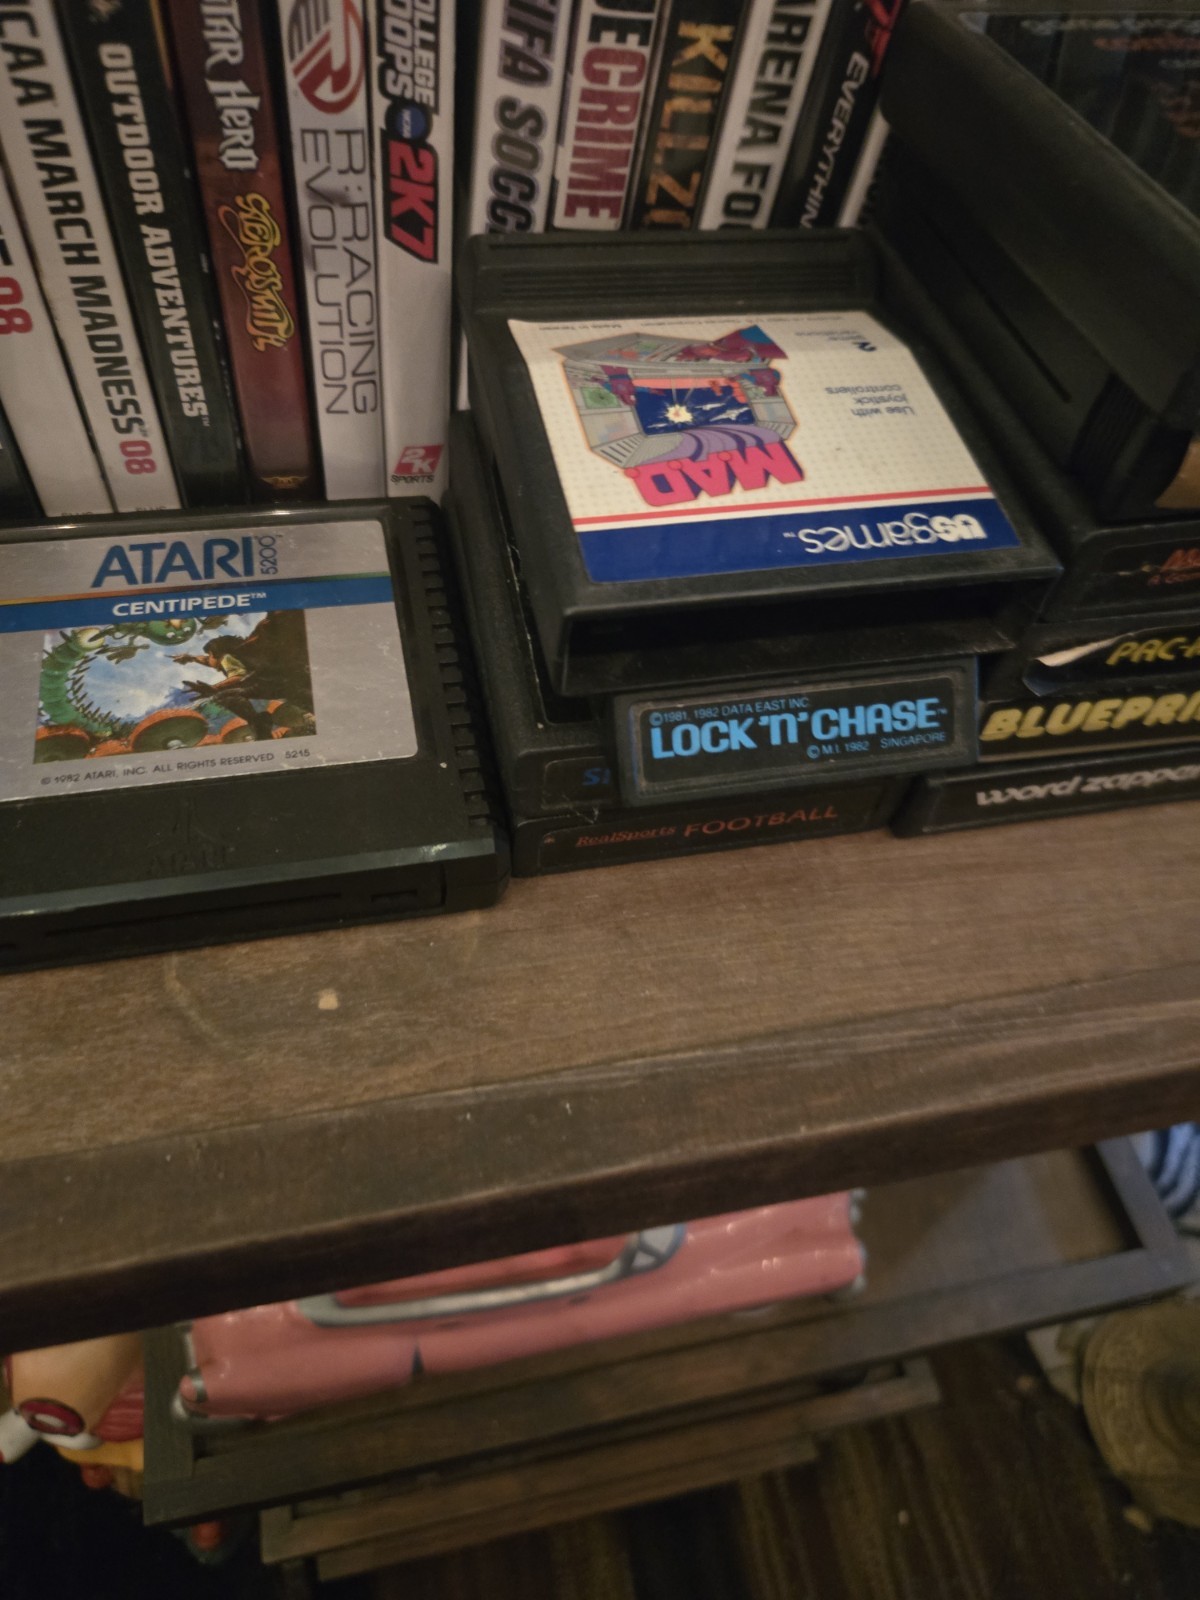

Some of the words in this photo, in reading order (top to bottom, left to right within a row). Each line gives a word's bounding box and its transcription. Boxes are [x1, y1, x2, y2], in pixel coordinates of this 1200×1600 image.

[0, 0, 58, 107] CAA
[500, 0, 557, 88] IFA
[737, 0, 813, 147] RENA
[99, 43, 165, 215] OUTDOOR
[487, 95, 545, 232] SOCC
[564, 47, 647, 219] CRIME
[23, 119, 100, 265] MARCH
[388, 140, 435, 263] 2K7
[718, 161, 772, 229] FO
[301, 129, 349, 415] EVOLUTION
[69, 275, 142, 434] MADNESS
[119, 440, 157, 475] 08
[90, 536, 255, 588] ATARI
[651, 718, 757, 759] LOCK
[694, 707, 719, 720] 1982
[722, 703, 753, 717] DATA
[755, 700, 787, 713] EAST
[845, 740, 870, 752] 1982
[880, 731, 947, 748] SINGAPORE
[979, 691, 1200, 741] BLUEPRI
[153, 761, 172, 774] ALL
[176, 757, 217, 772] RIGHTS
[220, 752, 275, 767] RESERVED
[285, 749, 311, 760] 5215
[683, 805, 839, 839] FOOTBALL
